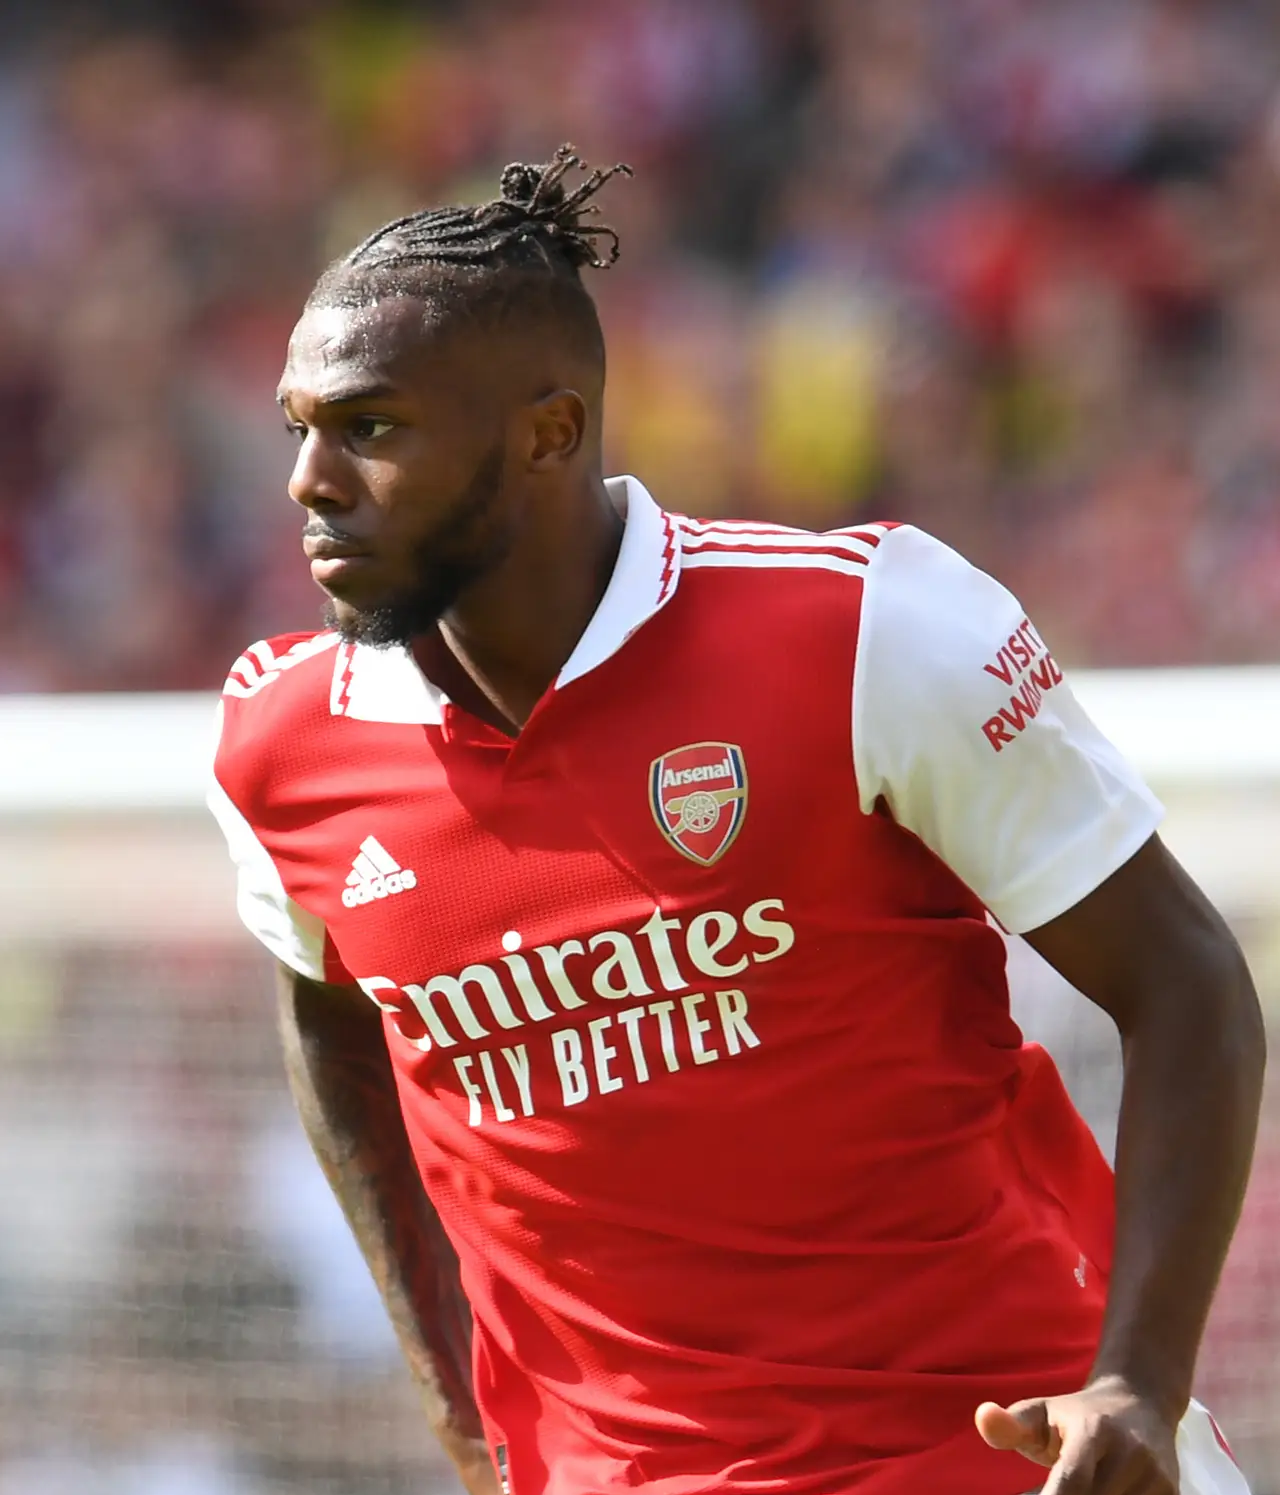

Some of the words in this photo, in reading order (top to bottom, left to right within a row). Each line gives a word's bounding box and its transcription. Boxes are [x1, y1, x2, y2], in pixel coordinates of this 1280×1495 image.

[983, 619, 1041, 686] VISIT
[663, 758, 732, 788] Arsenal
[342, 869, 417, 908] adidas
[356, 898, 795, 1052] Emirates
[453, 1044, 535, 1127] FLY
[551, 988, 761, 1107] BETTER
